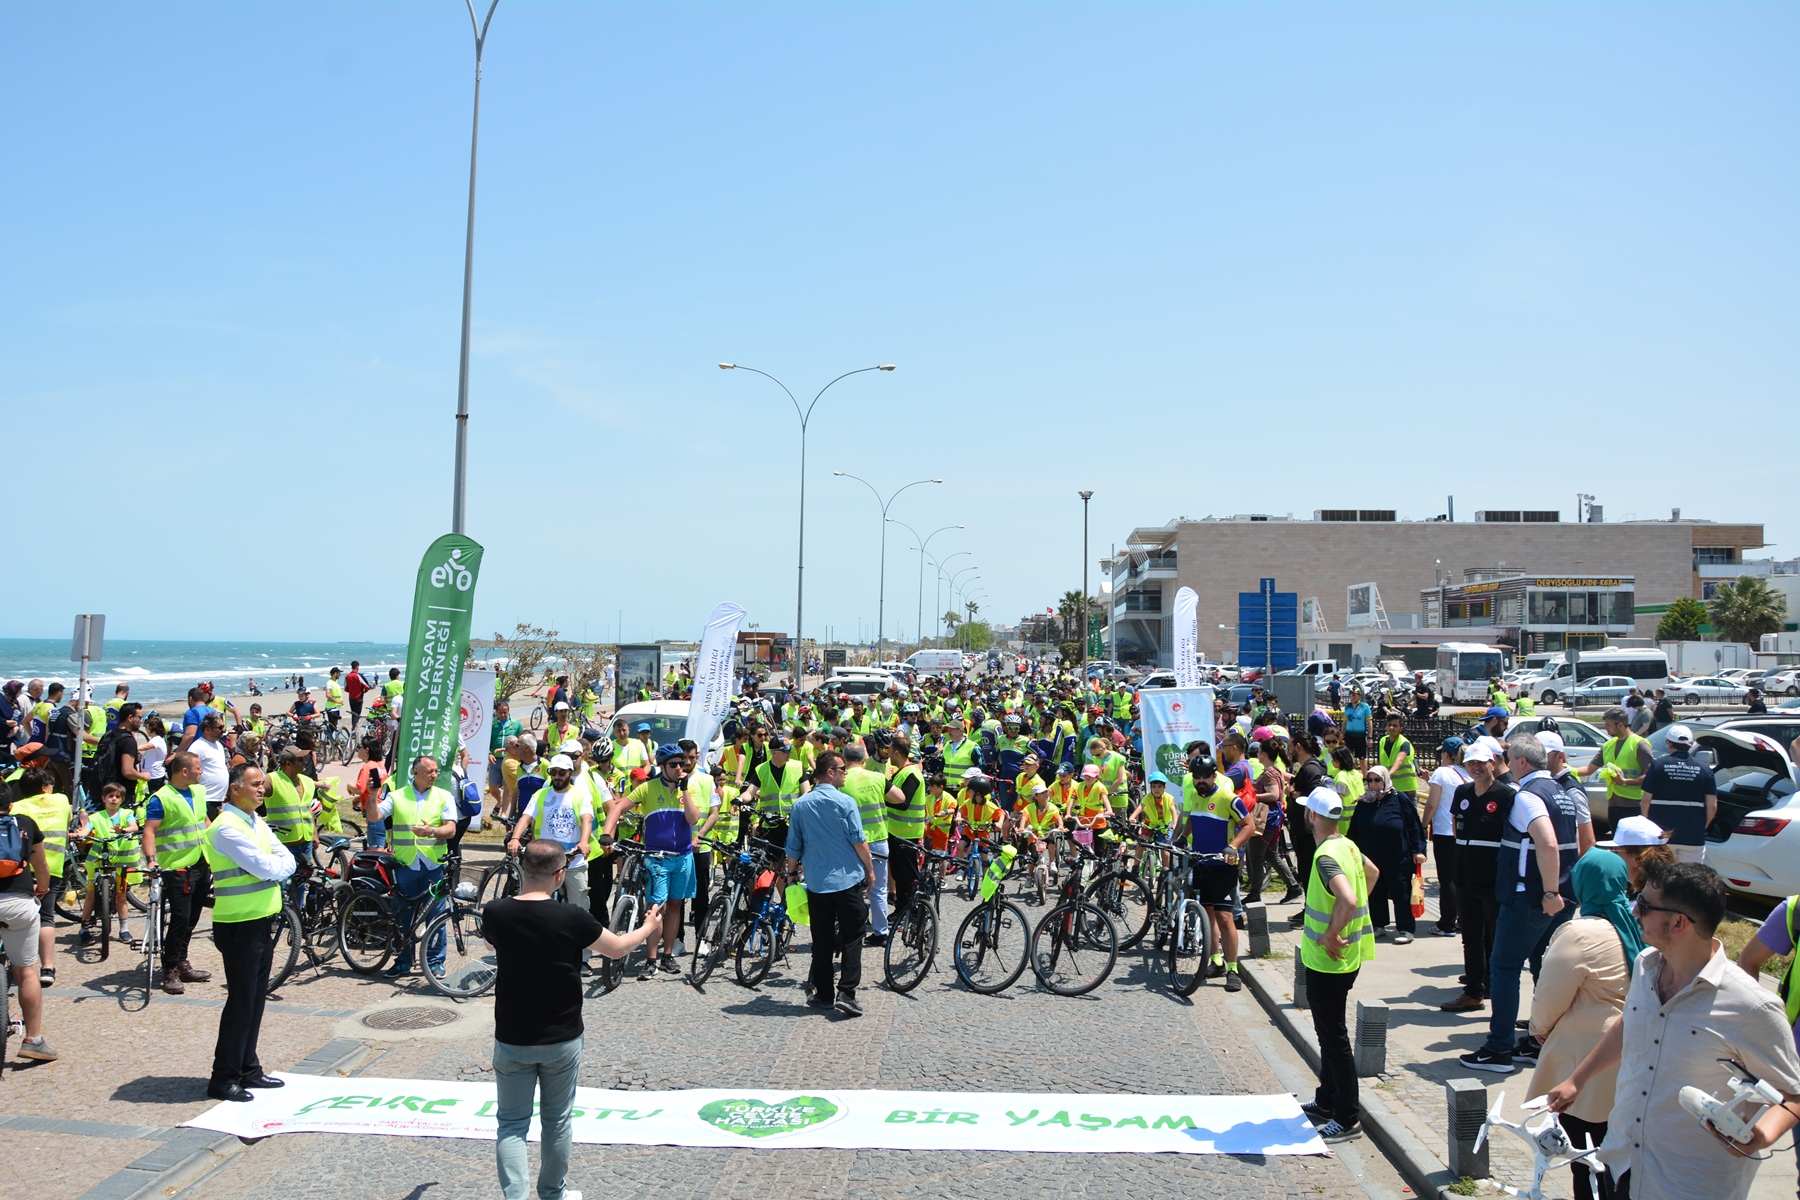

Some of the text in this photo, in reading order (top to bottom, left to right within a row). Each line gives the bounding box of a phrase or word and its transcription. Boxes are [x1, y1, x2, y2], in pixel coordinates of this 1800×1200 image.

[417, 619, 438, 694] YAŞAM
[427, 620, 452, 711] DERNEĞİ
[698, 672, 707, 685] T.C.
[703, 682, 715, 713] SAMSUN
[440, 706, 453, 732] için
[438, 734, 452, 767] doğa
[1163, 750, 1189, 760] TÜRKİ
[293, 1095, 664, 1121] ÇEVRE DSTU
[722, 1103, 816, 1113] TÜRKİYE
[728, 1112, 802, 1120] ÇEVRE
[884, 1108, 1199, 1131] BİR YAŞAM
[715, 1117, 810, 1125] HAFTASI
